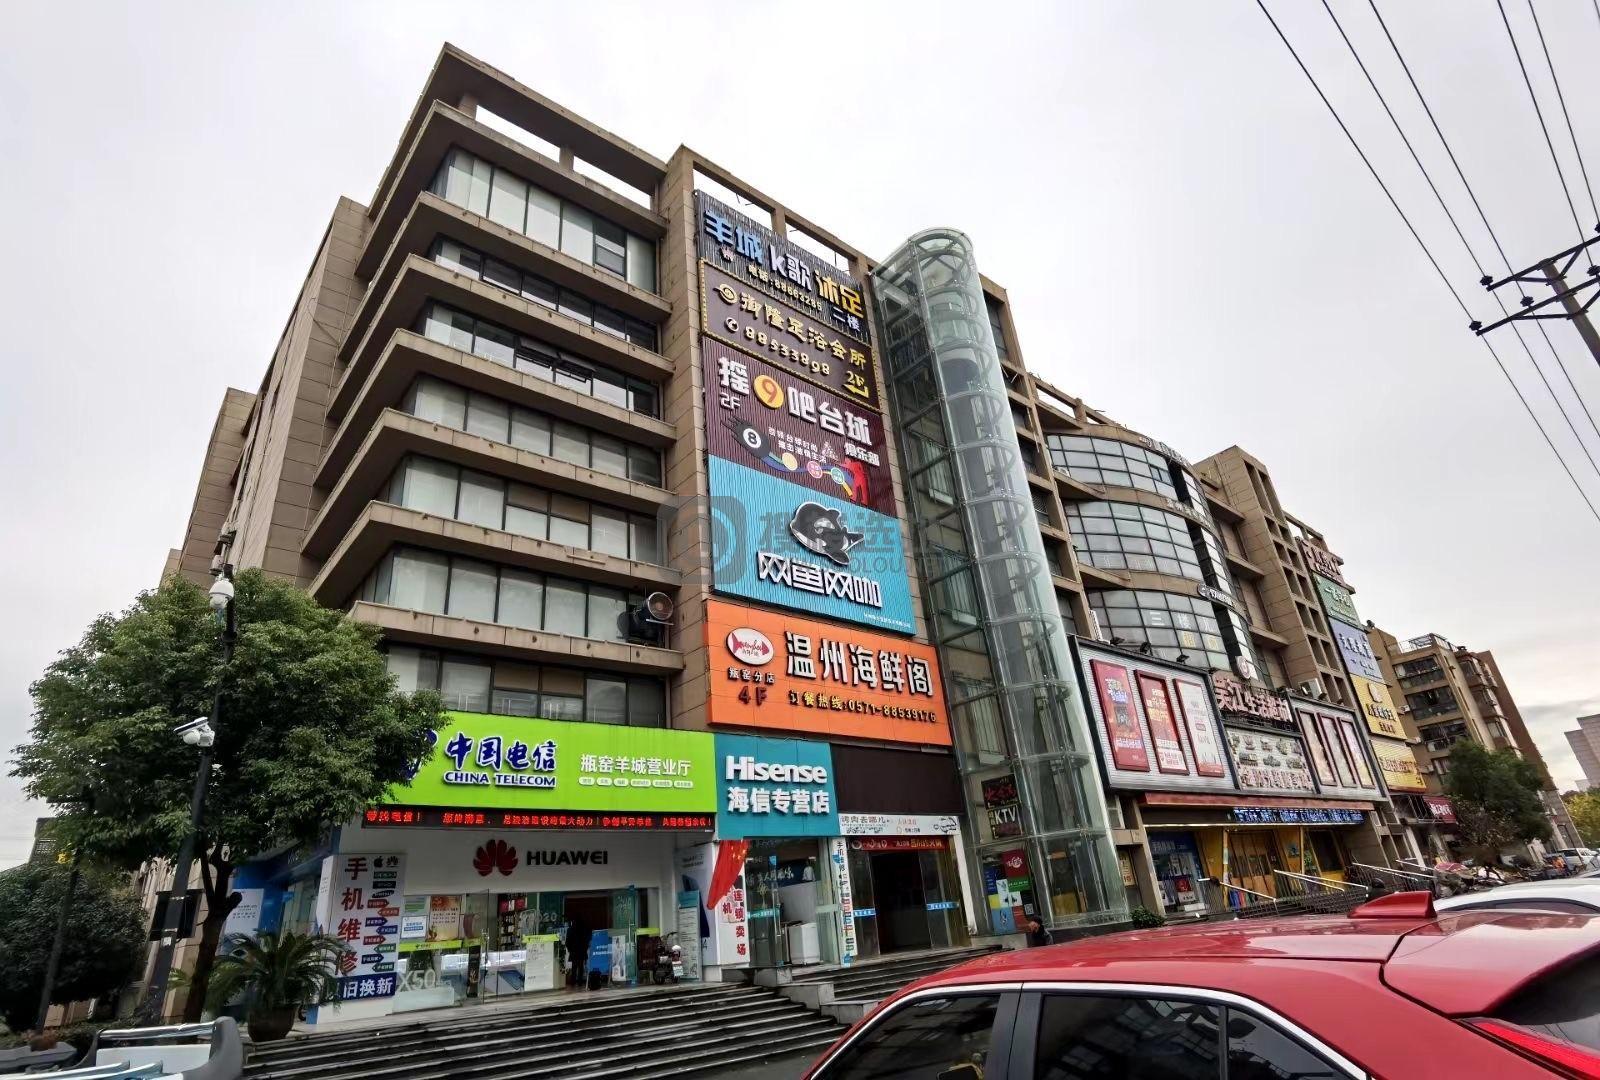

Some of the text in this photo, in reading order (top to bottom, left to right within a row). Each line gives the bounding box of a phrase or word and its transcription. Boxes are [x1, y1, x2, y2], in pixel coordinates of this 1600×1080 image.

[833, 306, 861, 332] 二楼
[745, 326, 831, 376] 88533898
[720, 393, 741, 409] 2F
[844, 442, 880, 467] 俱乐部
[758, 551, 882, 608] 网鱼网咖
[786, 631, 933, 696] 温州海鲜阁
[445, 731, 556, 771] 中国电信
[580, 754, 692, 776] 瓶窑羊城营业厅
[725, 755, 828, 784] Hisense
[444, 772, 556, 788] CHINA TELECOM
[727, 786, 830, 814] 海信专营店
[994, 805, 1017, 824] KTV
[527, 850, 608, 865] HUAWEI
[335, 857, 368, 976] 手机维修
